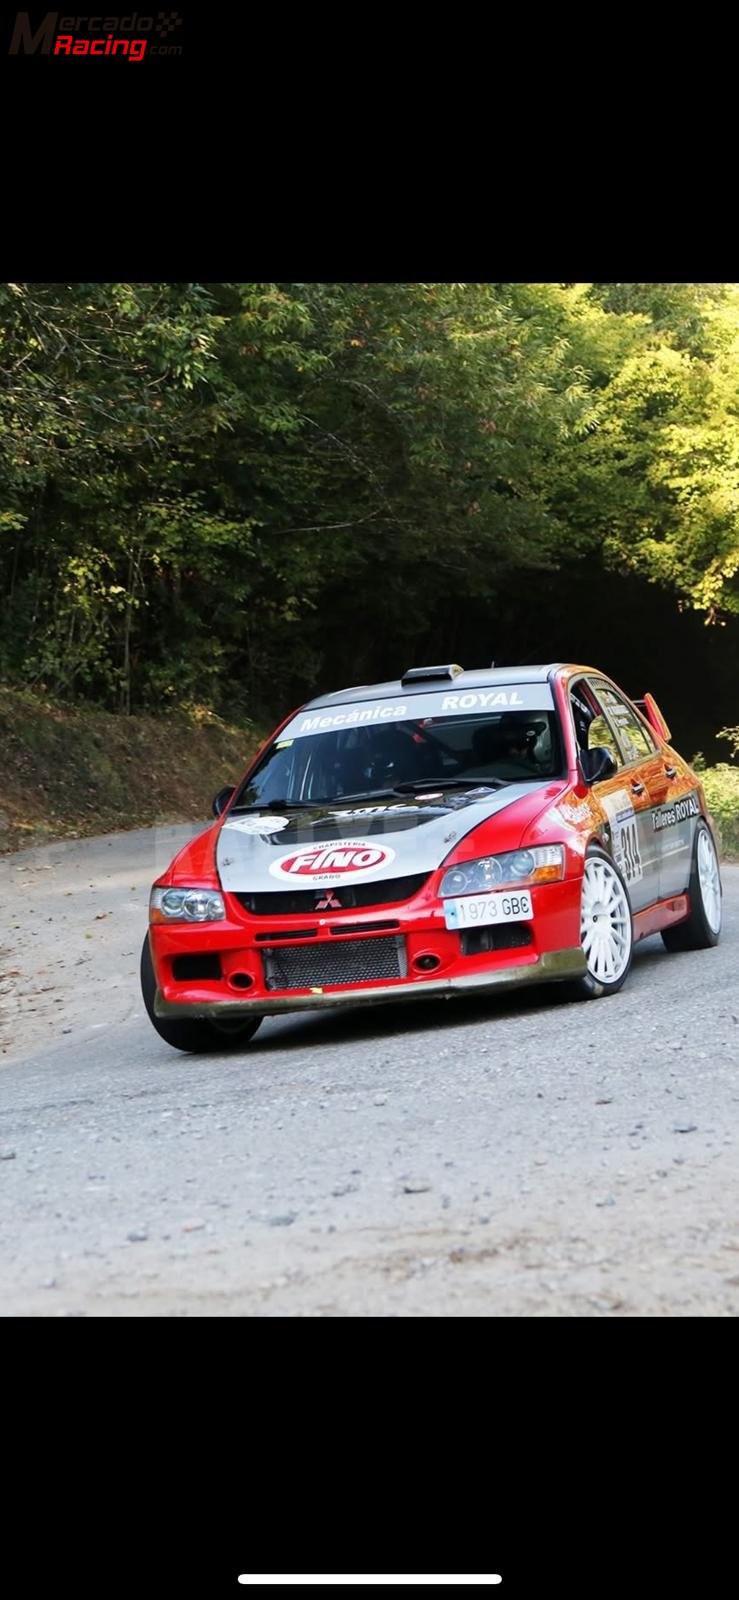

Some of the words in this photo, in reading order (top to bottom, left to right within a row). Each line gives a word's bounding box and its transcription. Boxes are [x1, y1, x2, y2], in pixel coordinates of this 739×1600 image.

[300, 705, 408, 733] Mecánica
[441, 692, 523, 711] ROYAL
[675, 793, 700, 821] ROYAL
[289, 847, 383, 874] FINO
[620, 823, 641, 881] 314
[460, 900, 498, 921] 1973
[502, 896, 530, 916] GBC
